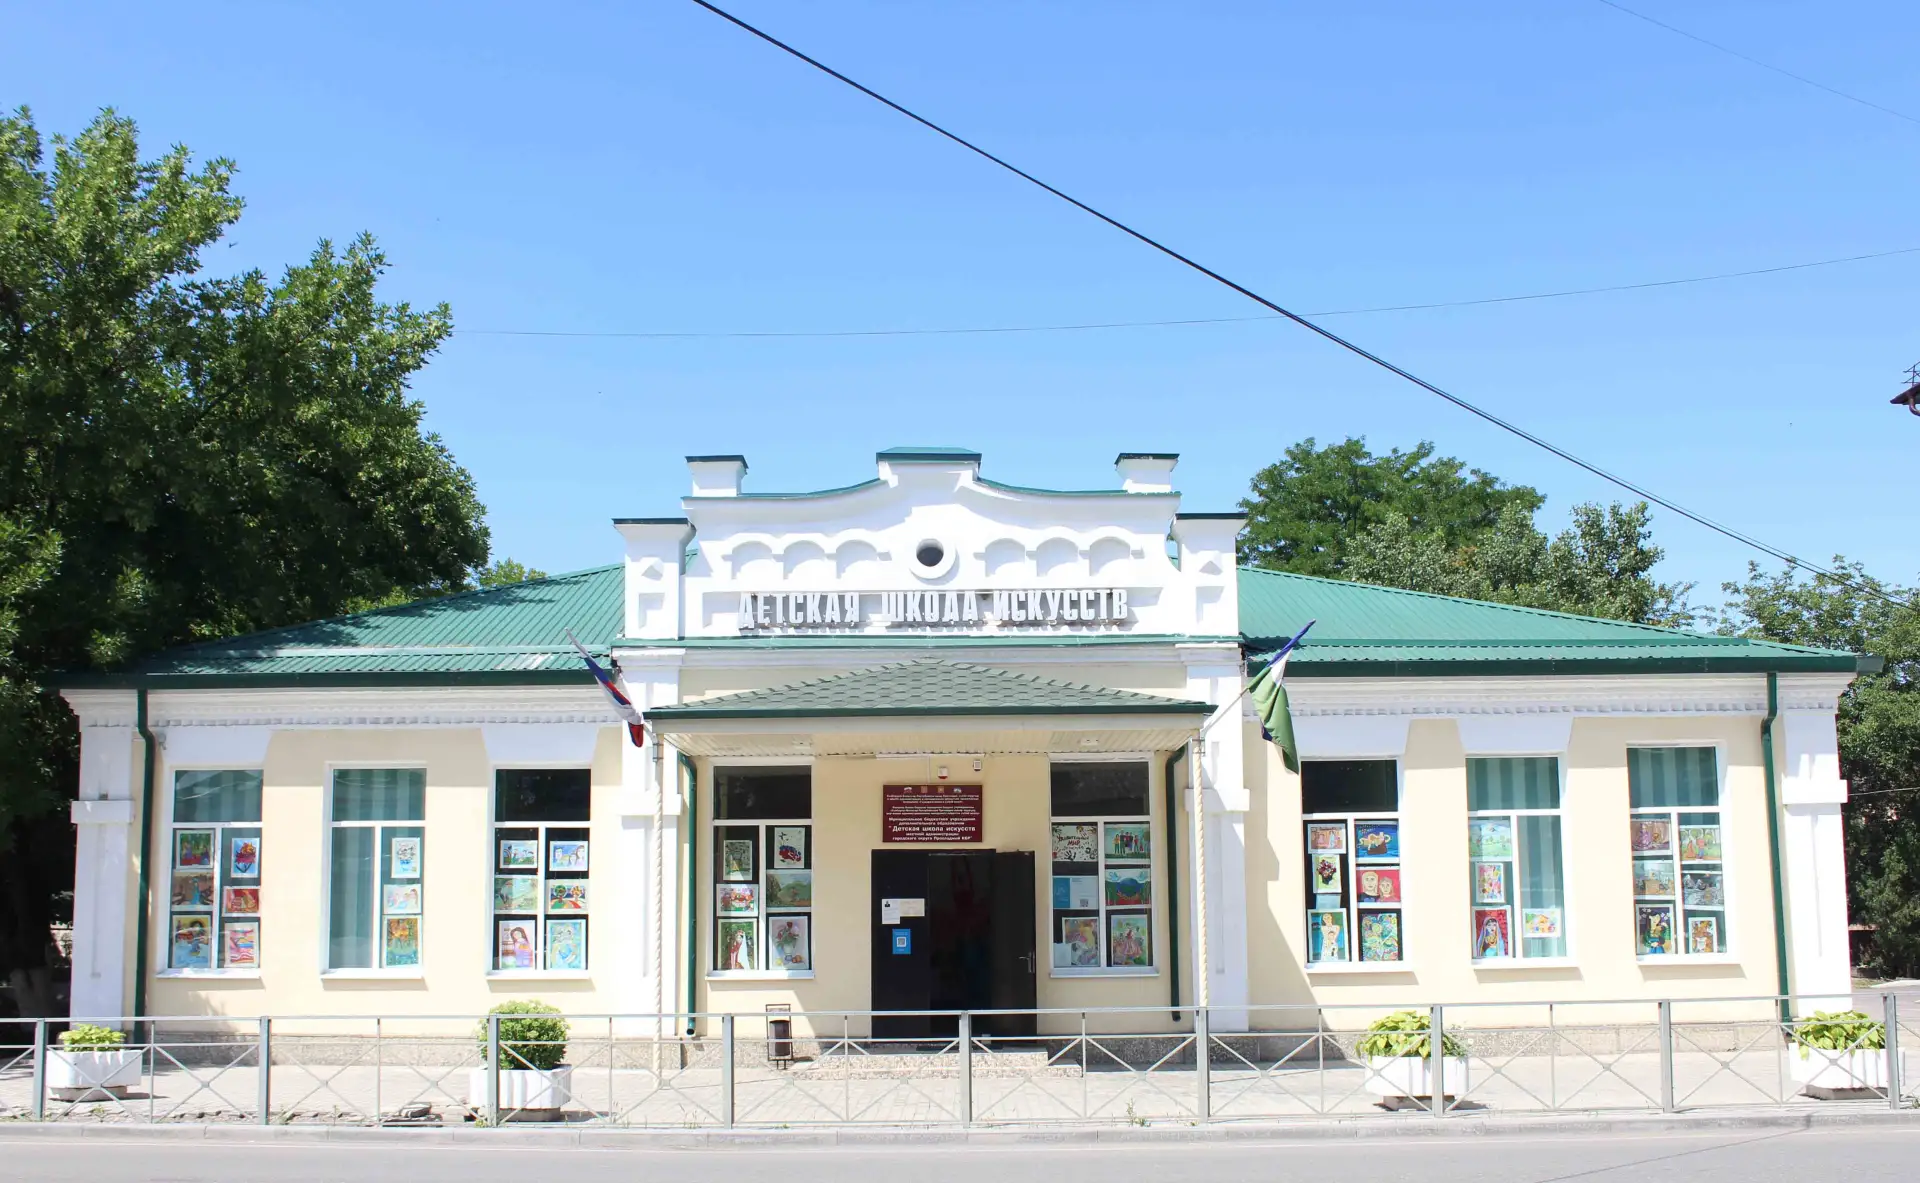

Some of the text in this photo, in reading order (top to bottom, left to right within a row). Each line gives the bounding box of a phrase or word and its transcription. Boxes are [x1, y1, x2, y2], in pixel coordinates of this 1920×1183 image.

[739, 589, 1129, 628] ДЕТСКАЯ ШКОЛА ИСКУССТВ
